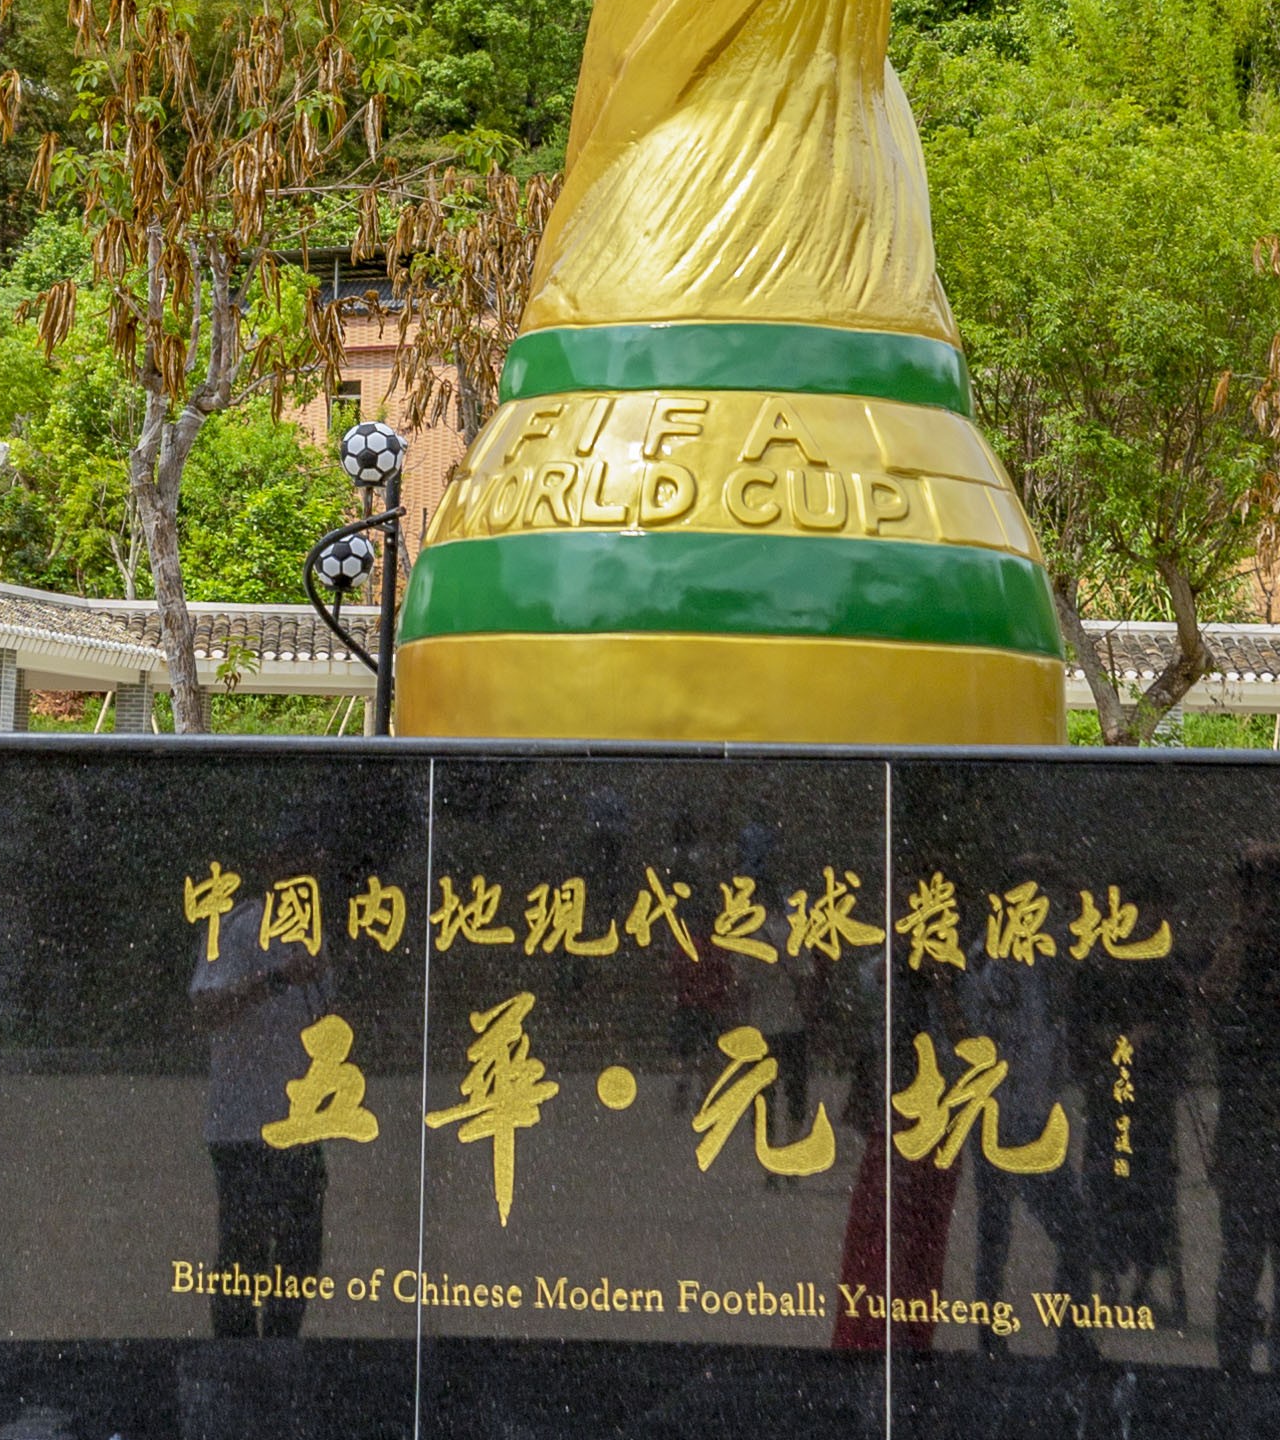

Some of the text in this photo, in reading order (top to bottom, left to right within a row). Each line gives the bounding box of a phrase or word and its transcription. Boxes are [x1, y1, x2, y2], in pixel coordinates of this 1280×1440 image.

[506, 396, 827, 466] FIFA
[425, 460, 910, 542] WORLD CUP
[172, 1260, 1156, 1336] Birthplace of Chinese Modern Football: Yuankeng, Wuhua
